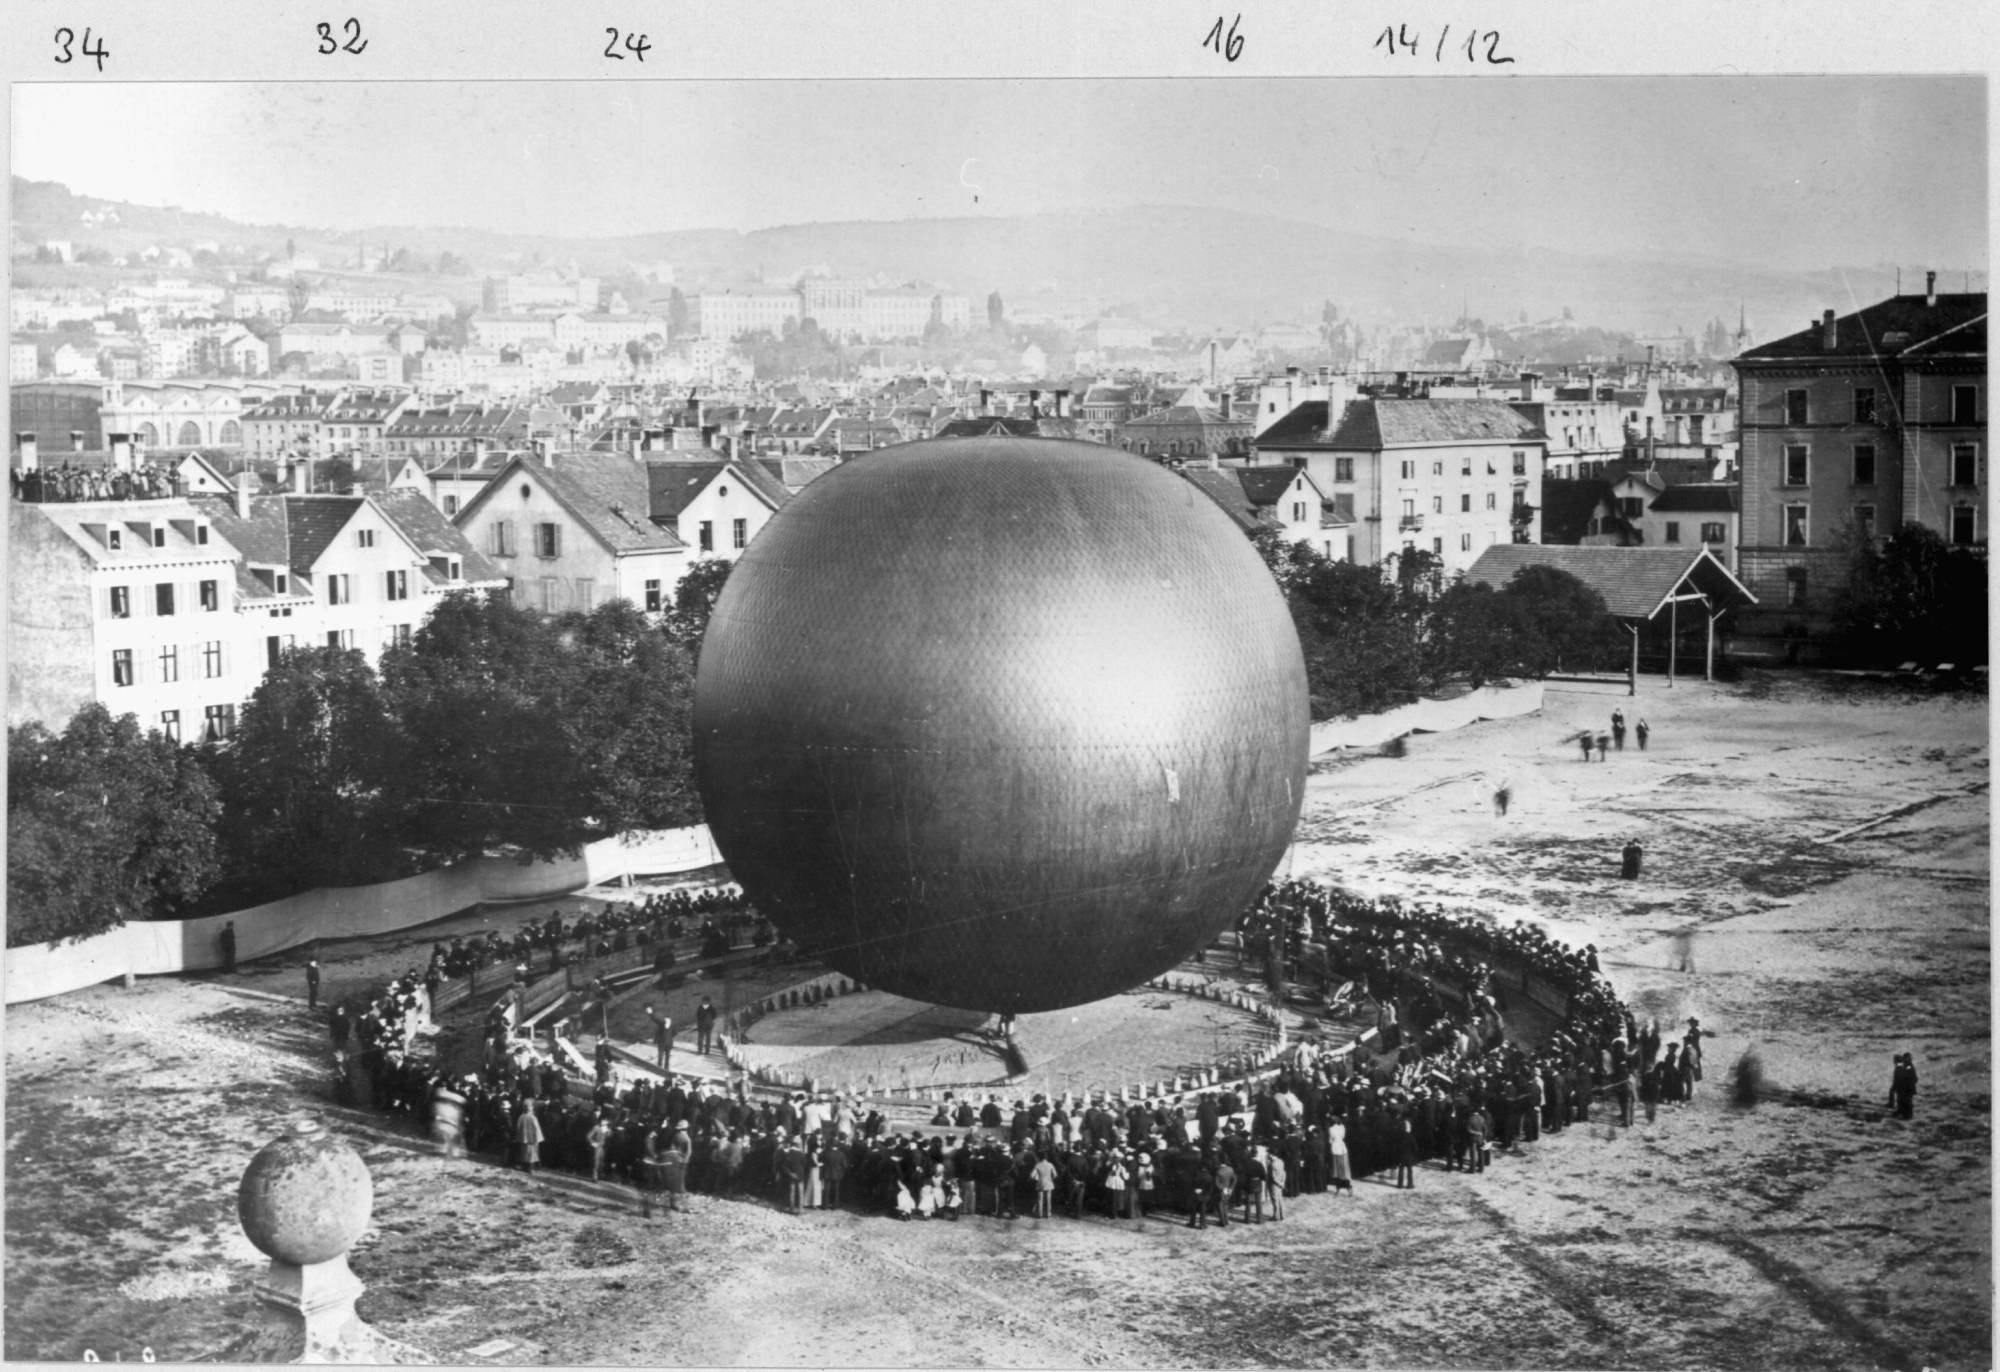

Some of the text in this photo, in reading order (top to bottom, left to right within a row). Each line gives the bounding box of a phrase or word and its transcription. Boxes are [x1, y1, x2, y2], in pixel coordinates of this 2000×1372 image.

[54, 27, 110, 72] 34
[316, 17, 368, 55] 32
[603, 28, 652, 62] 24
[1202, 14, 1245, 62] 16
